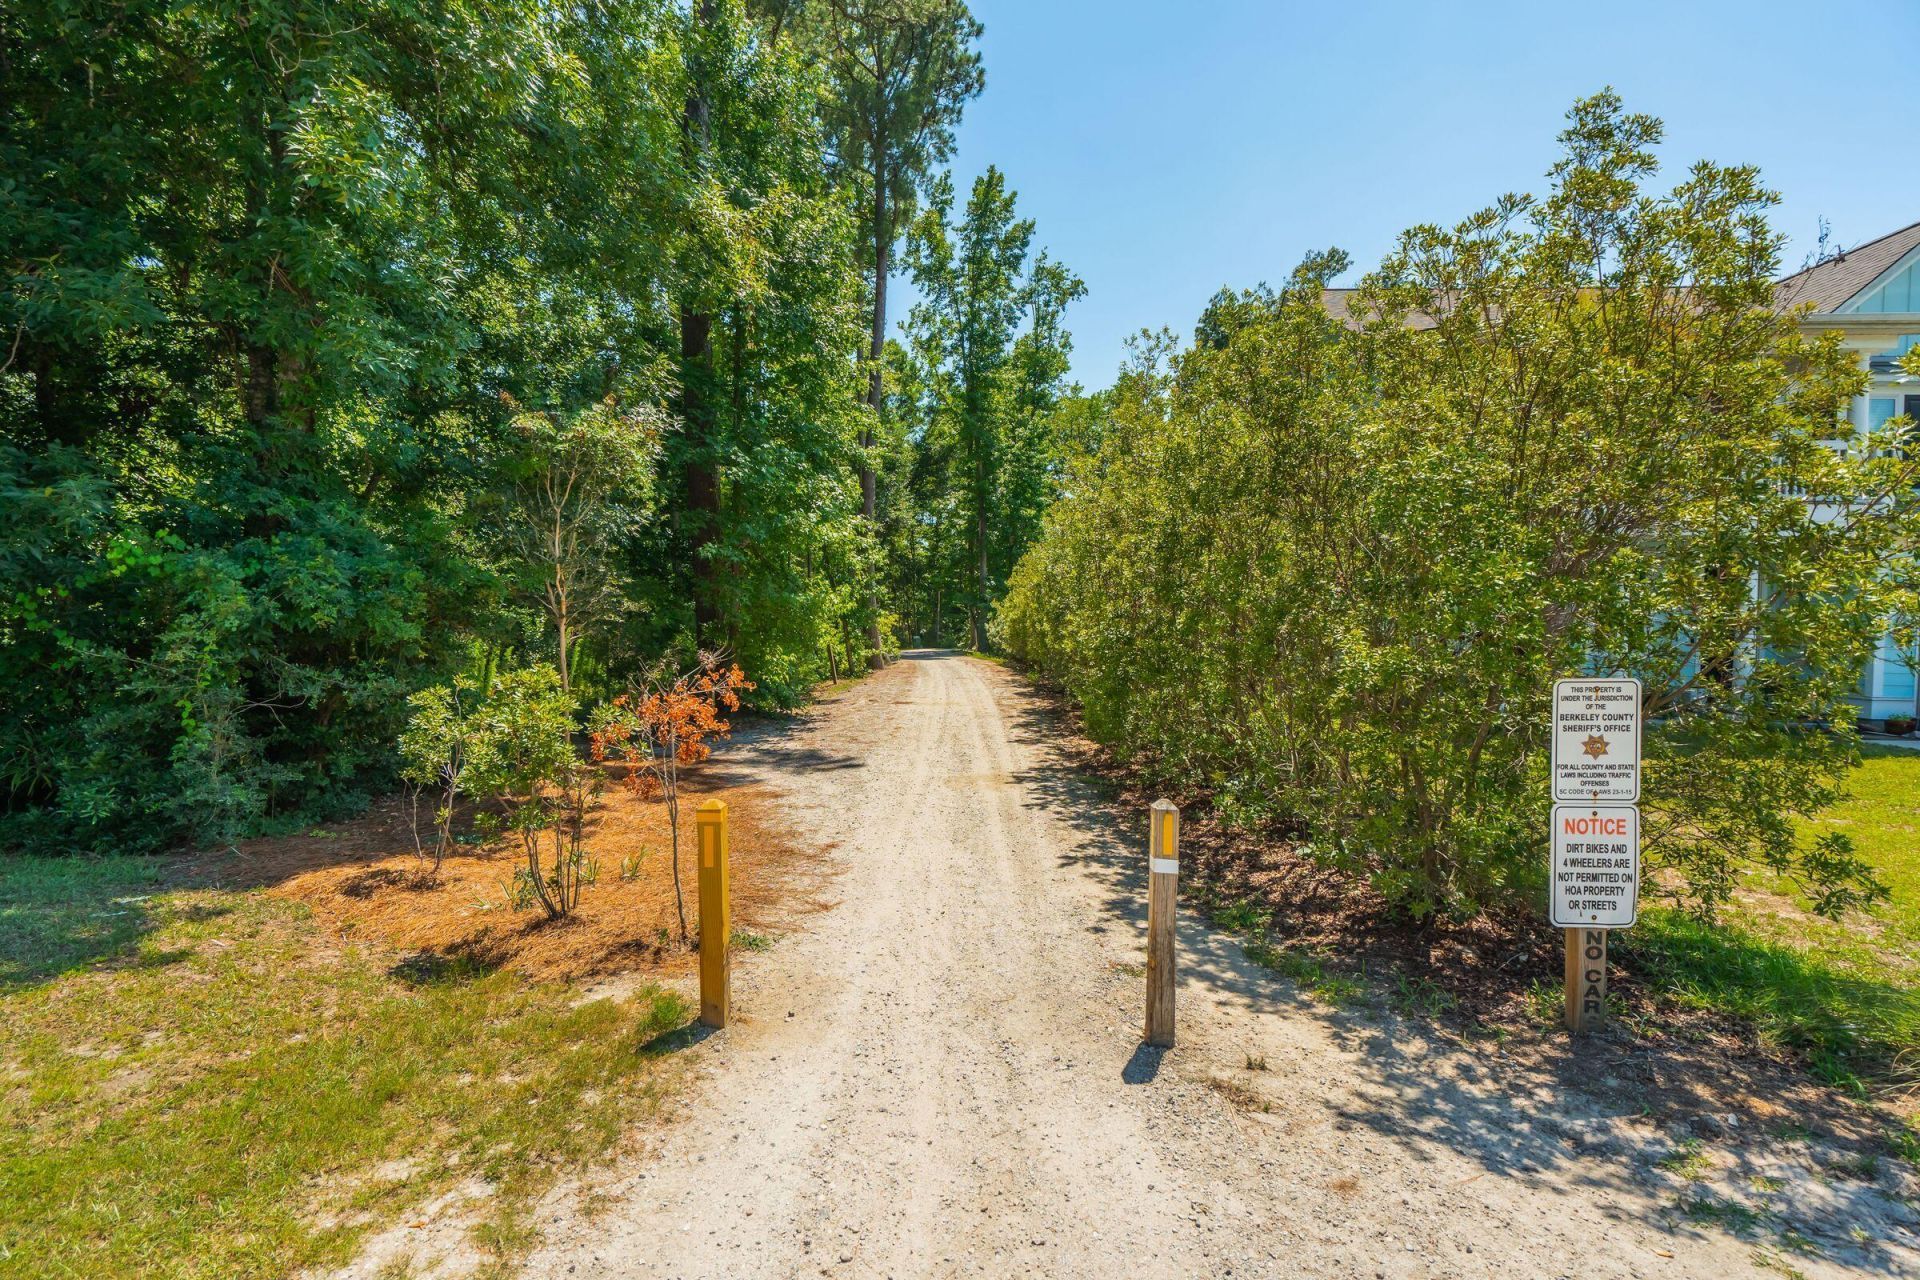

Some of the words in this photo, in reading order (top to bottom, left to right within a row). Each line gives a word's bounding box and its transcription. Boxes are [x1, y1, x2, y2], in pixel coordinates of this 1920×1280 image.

[1564, 818, 1626, 835] NOTICE
[1566, 844, 1584, 853] DIRT
[1586, 844, 1609, 854] BIKES
[1610, 844, 1627, 854] AND
[1563, 858, 1568, 867] 4
[1569, 858, 1612, 868] WHEELERS
[1614, 859, 1630, 868] ARE
[1558, 872, 1574, 882] NOT
[1576, 872, 1619, 882] PERMITTED
[1622, 873, 1633, 883] ON
[1565, 886, 1582, 895] HOA
[1584, 886, 1625, 896] PROPERTY
[1568, 900, 1580, 910] OR
[1582, 900, 1617, 911] STREETS
[1585, 931, 1603, 960] NO
